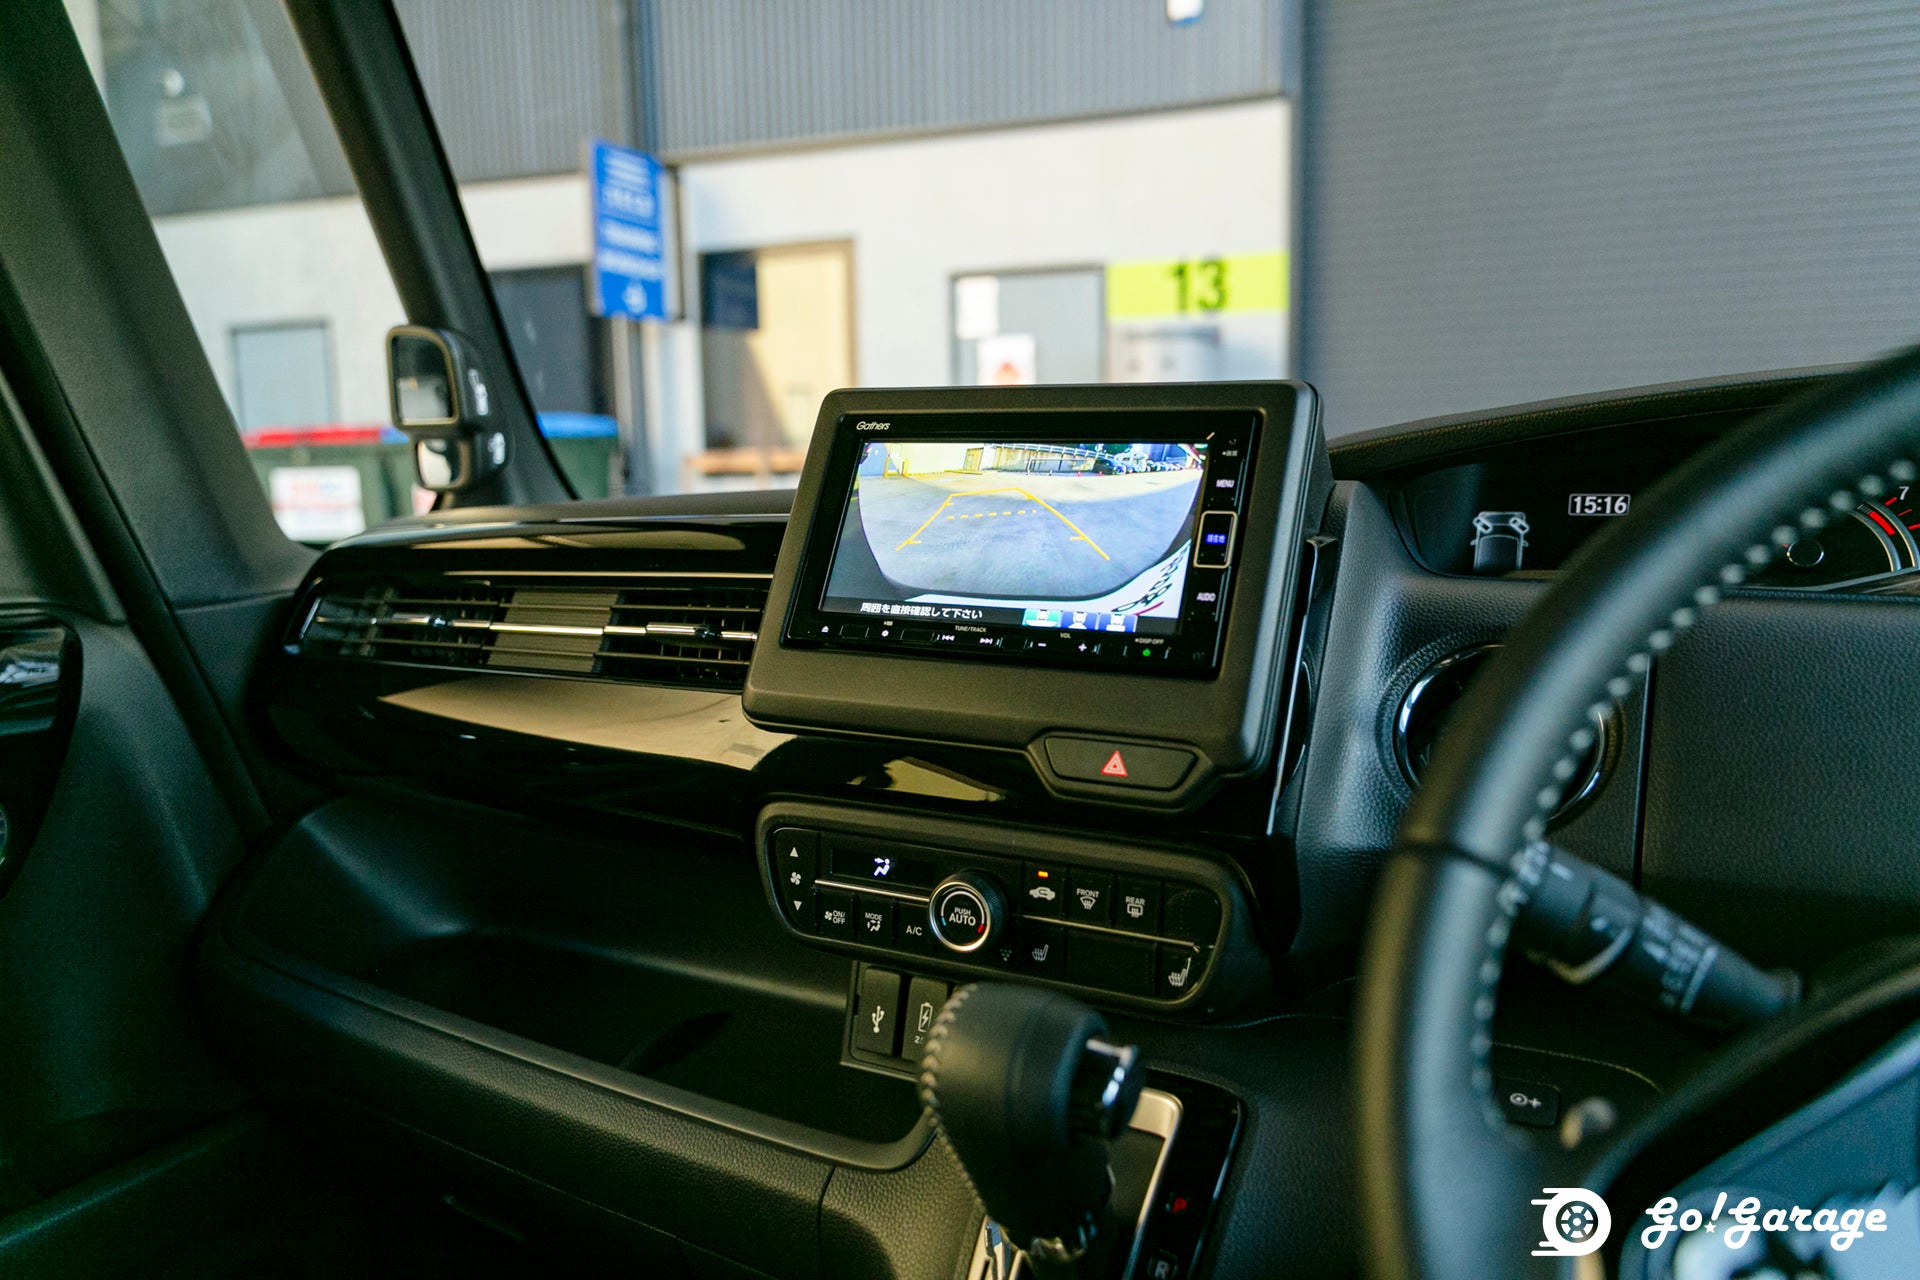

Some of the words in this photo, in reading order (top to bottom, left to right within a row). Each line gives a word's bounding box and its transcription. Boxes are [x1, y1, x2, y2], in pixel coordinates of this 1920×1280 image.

[1167, 256, 1227, 315] 13
[856, 421, 891, 430] Gathers
[1215, 479, 1235, 488] MENU
[1899, 486, 1910, 500] 7
[1573, 496, 1627, 514] 15:16
[860, 602, 983, 619] 周囲を直接確認して下さい
[954, 625, 987, 633] TUNE/TRACK
[1076, 888, 1100, 898] FRONT
[1125, 896, 1146, 906] REAR
[832, 910, 846, 918] ON/
[865, 912, 883, 921] MODE
[954, 907, 972, 916] PUSH
[832, 916, 846, 925] OFF
[949, 913, 976, 926] AUTO
[906, 925, 923, 936] A/C
[1171, 1197, 1188, 1214] P
[1154, 1260, 1170, 1280] R
